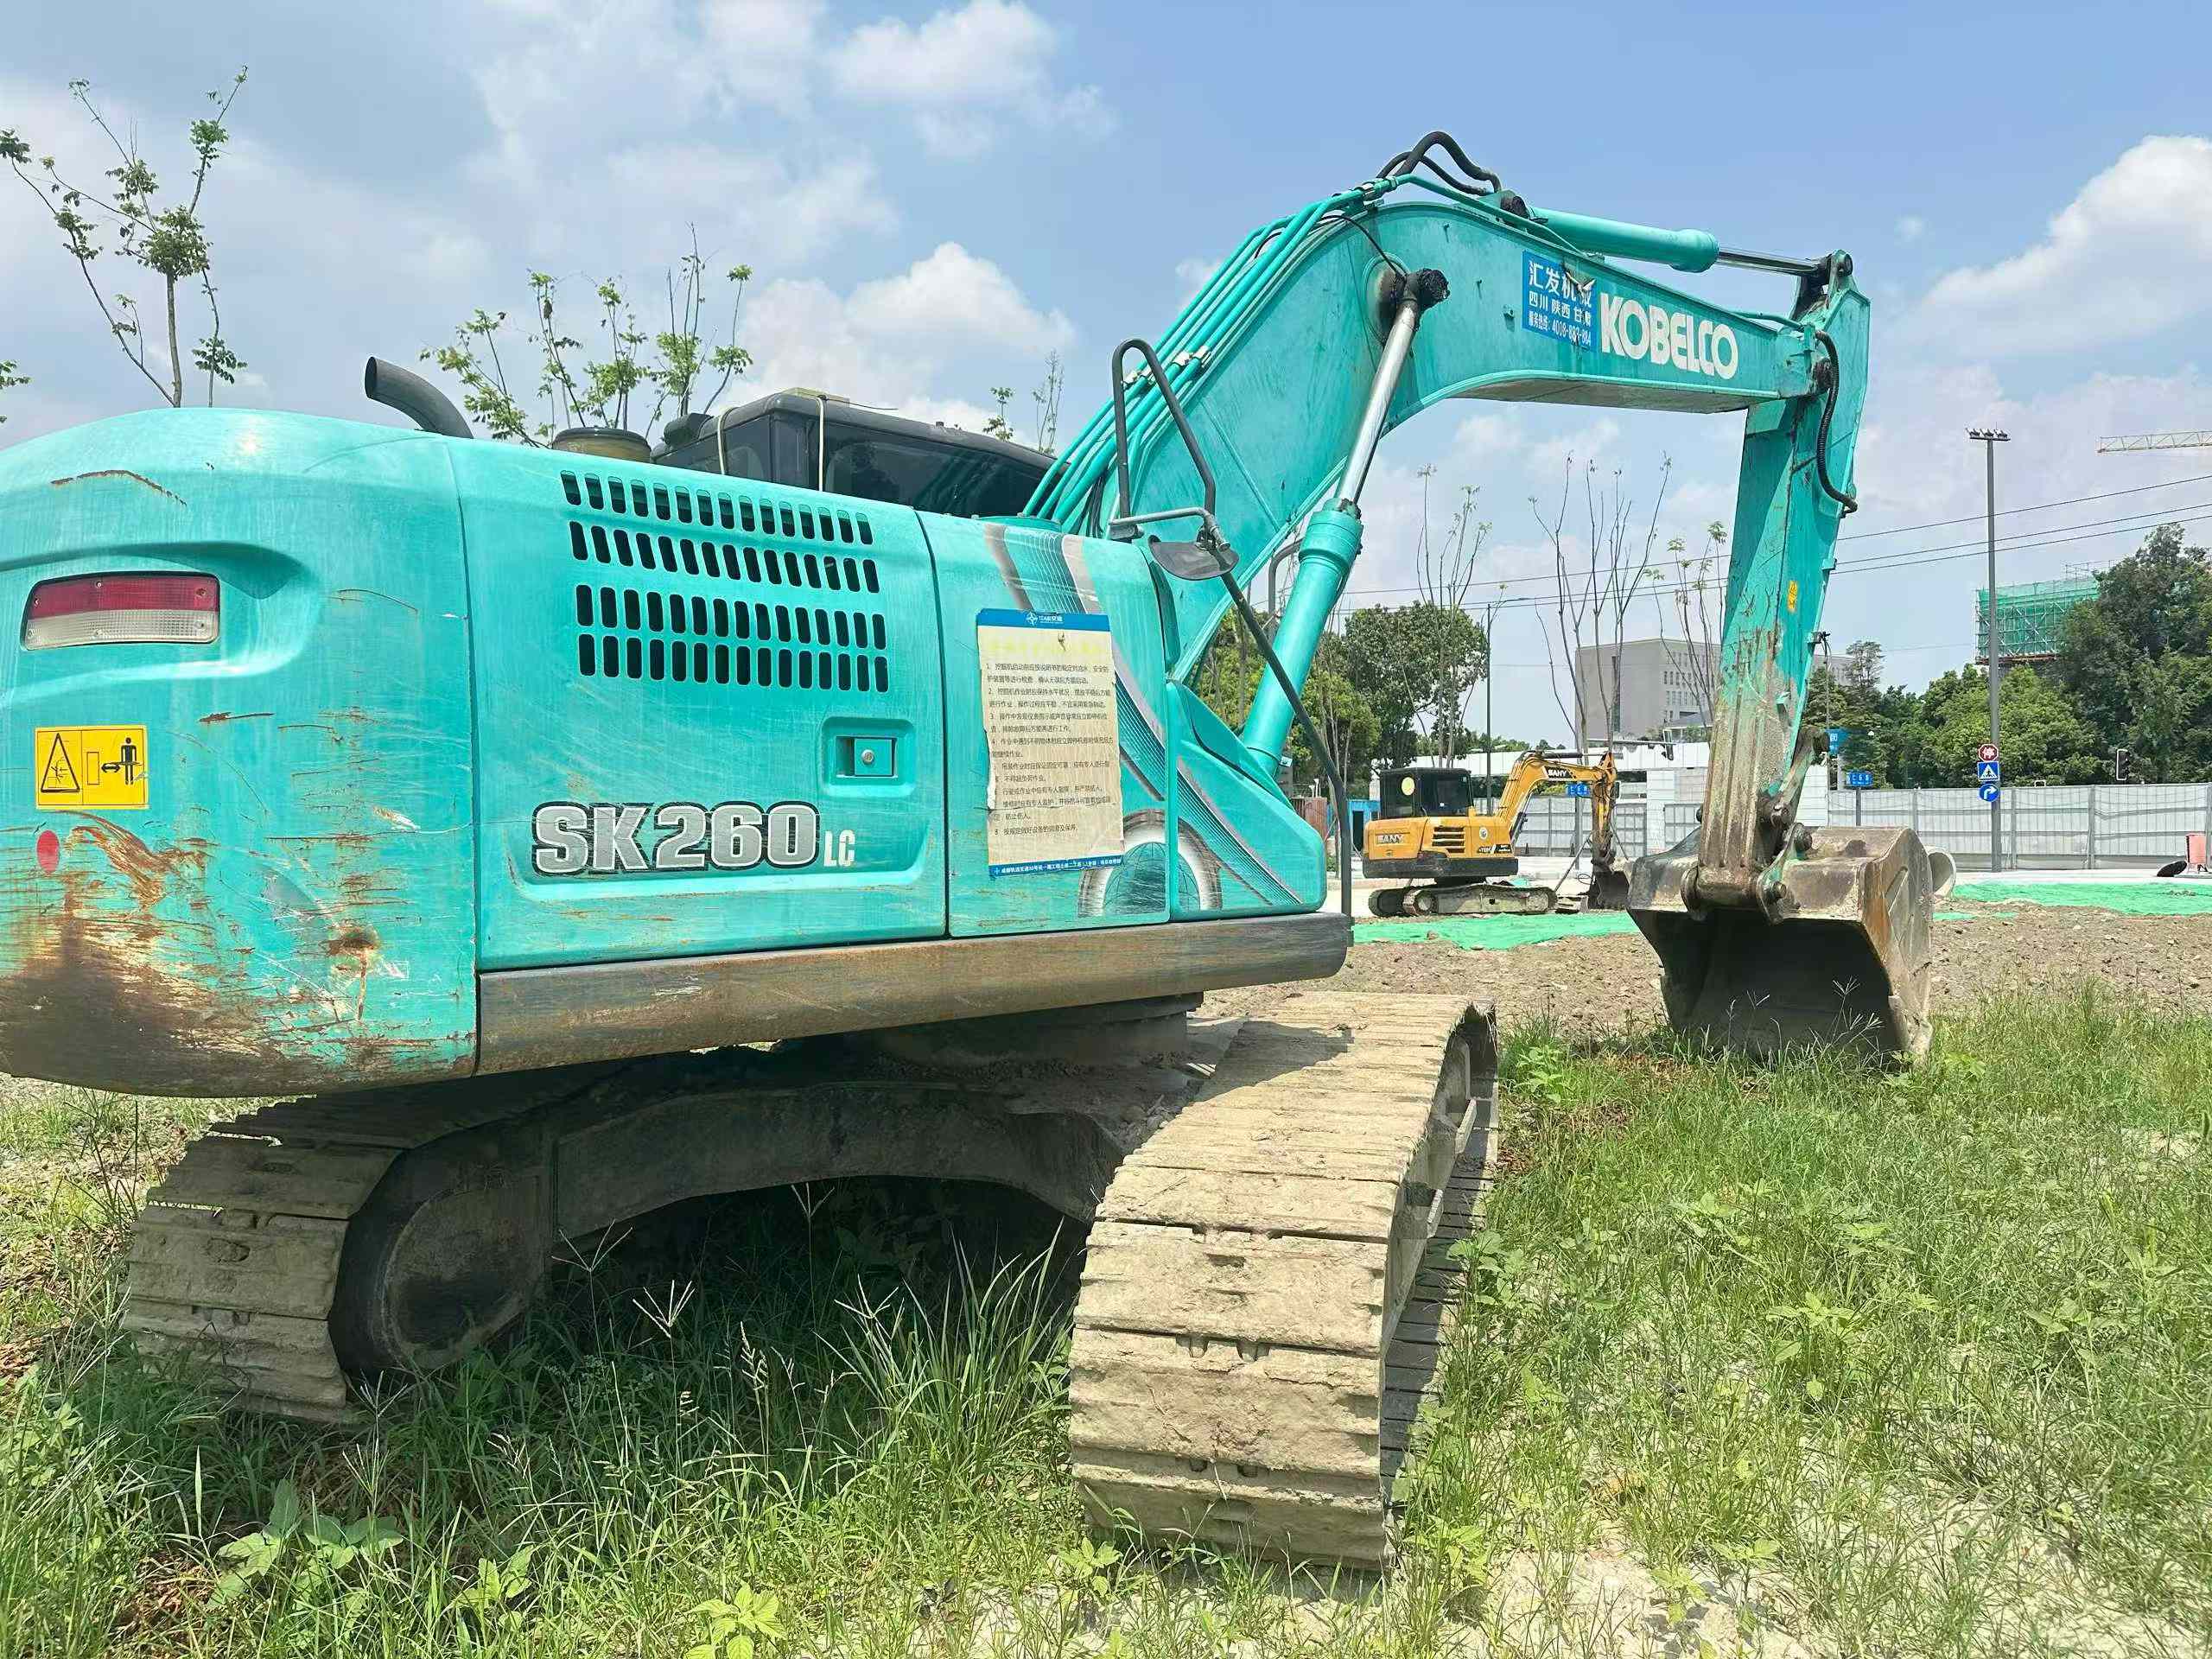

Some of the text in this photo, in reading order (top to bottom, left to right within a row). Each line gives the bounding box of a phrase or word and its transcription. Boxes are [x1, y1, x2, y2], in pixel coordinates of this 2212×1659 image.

[1529, 290, 1548, 312] 四川
[1551, 299, 1571, 319] 陕西
[1599, 292, 1738, 380] KOBELCO
[531, 800, 855, 875] SK260 LC
